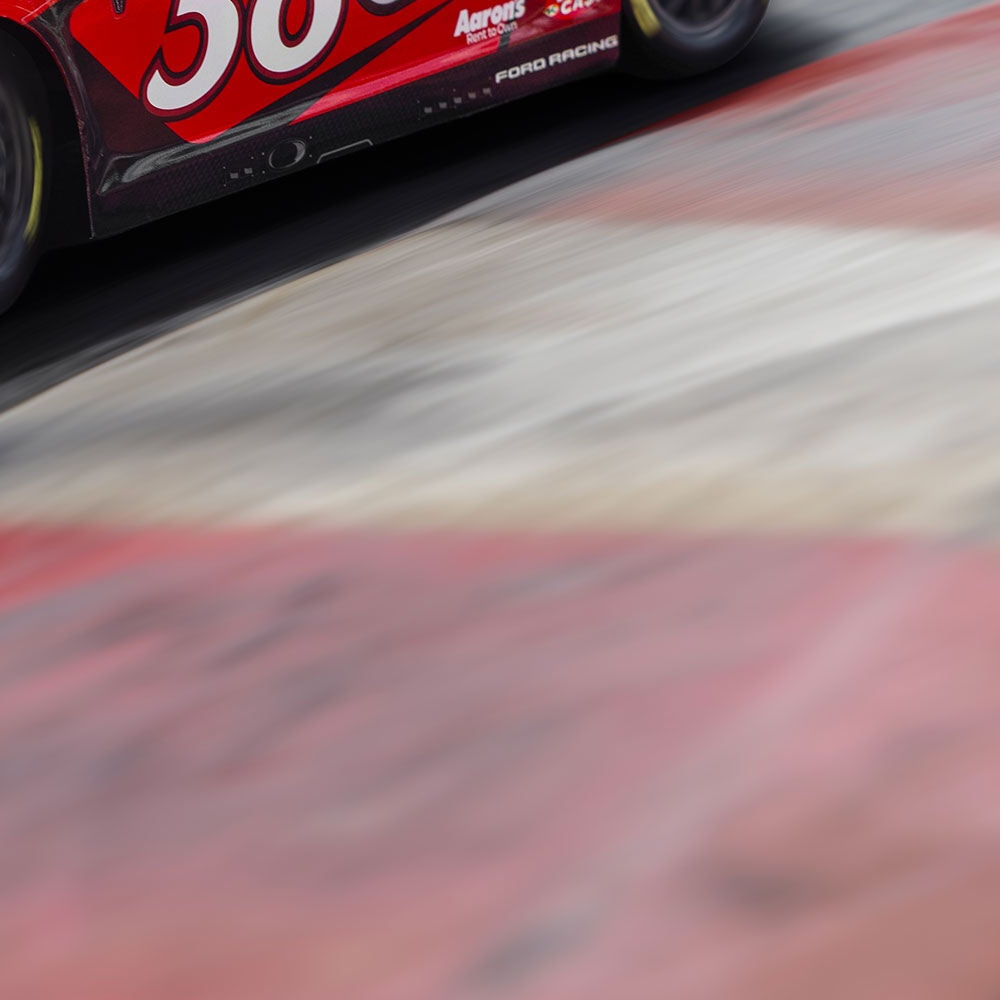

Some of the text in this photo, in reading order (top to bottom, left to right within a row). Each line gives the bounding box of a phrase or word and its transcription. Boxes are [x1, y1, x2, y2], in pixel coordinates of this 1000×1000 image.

[466, 21, 518, 45] Rent to Own
[495, 35, 619, 84] FORD RACING
